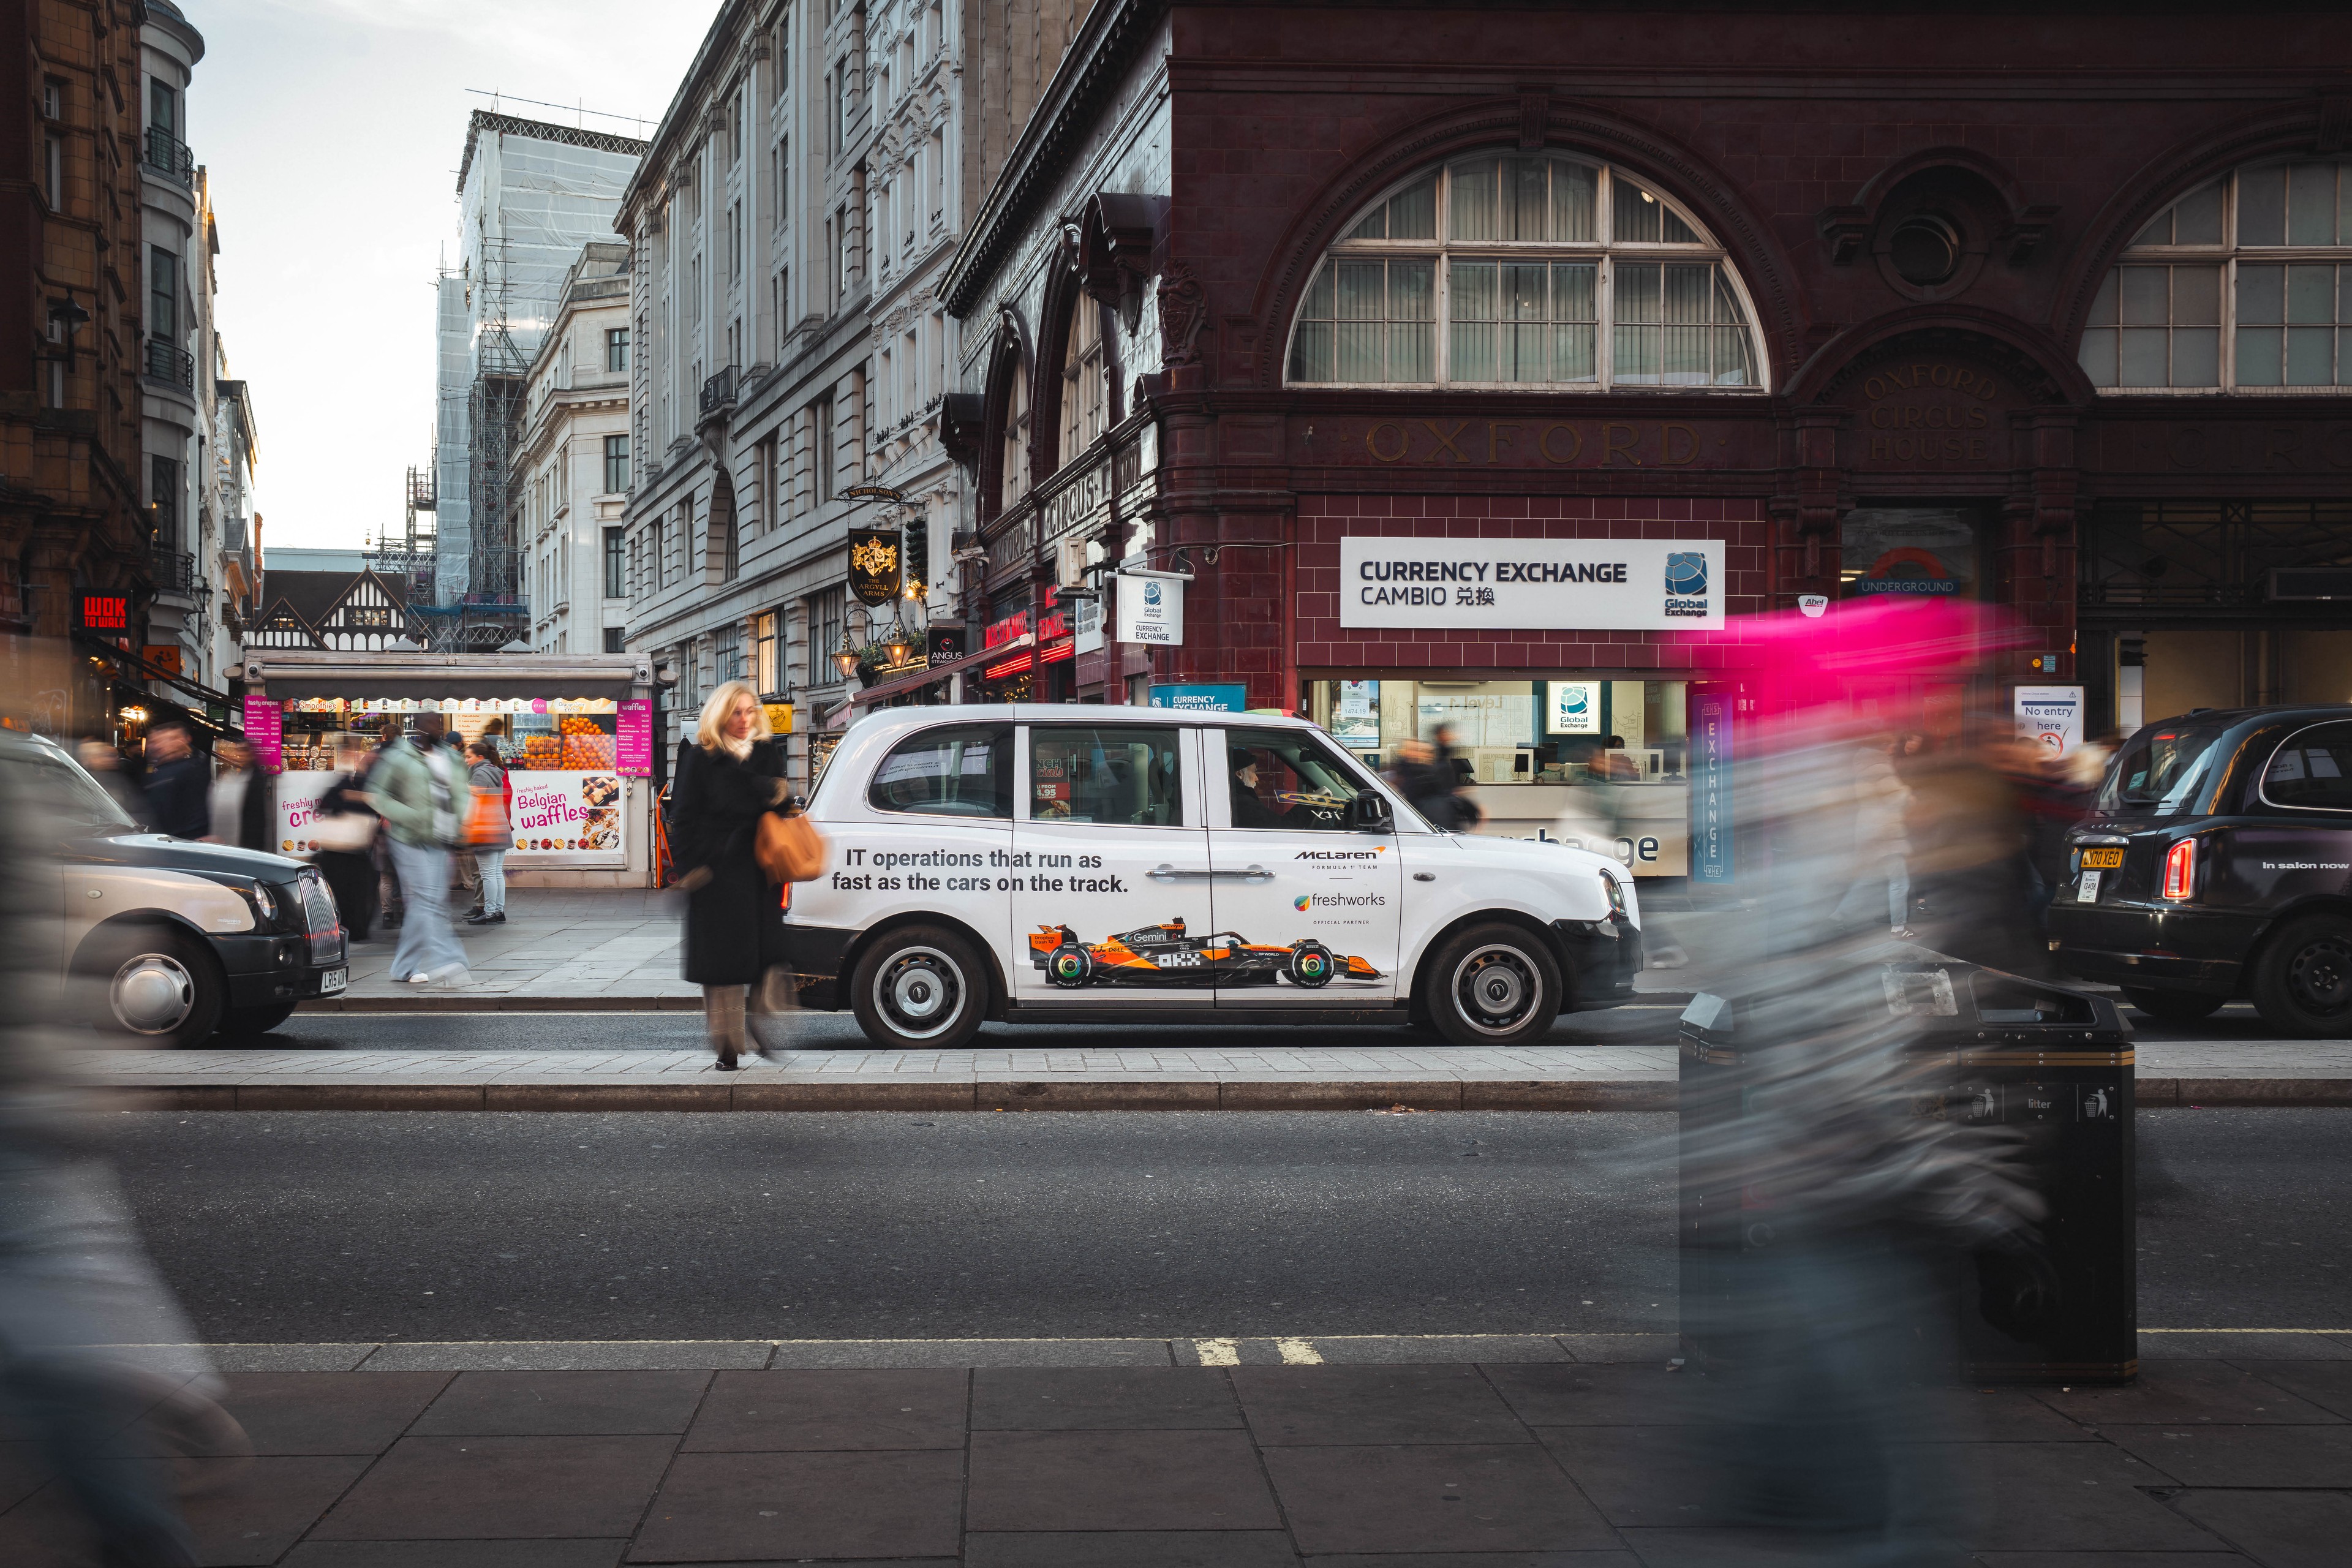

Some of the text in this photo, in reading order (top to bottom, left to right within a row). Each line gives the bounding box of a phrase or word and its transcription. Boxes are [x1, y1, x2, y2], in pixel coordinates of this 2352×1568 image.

[1864, 364, 1996, 400] OXFORD
[1871, 406, 1988, 428] CIRCUS
[1366, 420, 1701, 466] OXFORD
[1870, 437, 1989, 461] HOUSE
[850, 487, 900, 499] NICHOLSON'S
[1049, 474, 1094, 535] CIRCUS
[1360, 560, 1627, 583] CURRENCY EXCHANGE
[1862, 582, 1953, 592] UNDERGROUND
[1361, 586, 1447, 606] CAMBIO
[1665, 599, 1708, 609] Global
[84, 597, 126, 617] WOK
[1665, 608, 1708, 618] Exchange
[85, 617, 126, 628] TO WALK
[1136, 632, 1169, 641] EXCHANGE
[2025, 707, 2073, 717] No entry
[2037, 722, 2061, 730] here
[1036, 759, 1061, 768] NCH
[1036, 766, 1063, 777] cials
[1708, 722, 1717, 858] EXCHANGE
[282, 797, 313, 810] freshly
[518, 793, 567, 810] Belgian
[290, 809, 324, 827] cre
[521, 802, 589, 829] waffles
[846, 849, 1102, 870] IT operations that run as
[832, 872, 1128, 893] fast as the cars on the track.
[1312, 892, 1385, 906] freshworks
[1134, 932, 1167, 941] Gemini
[325, 971, 337, 989] LR15
[2028, 1098, 2051, 1109] litter
